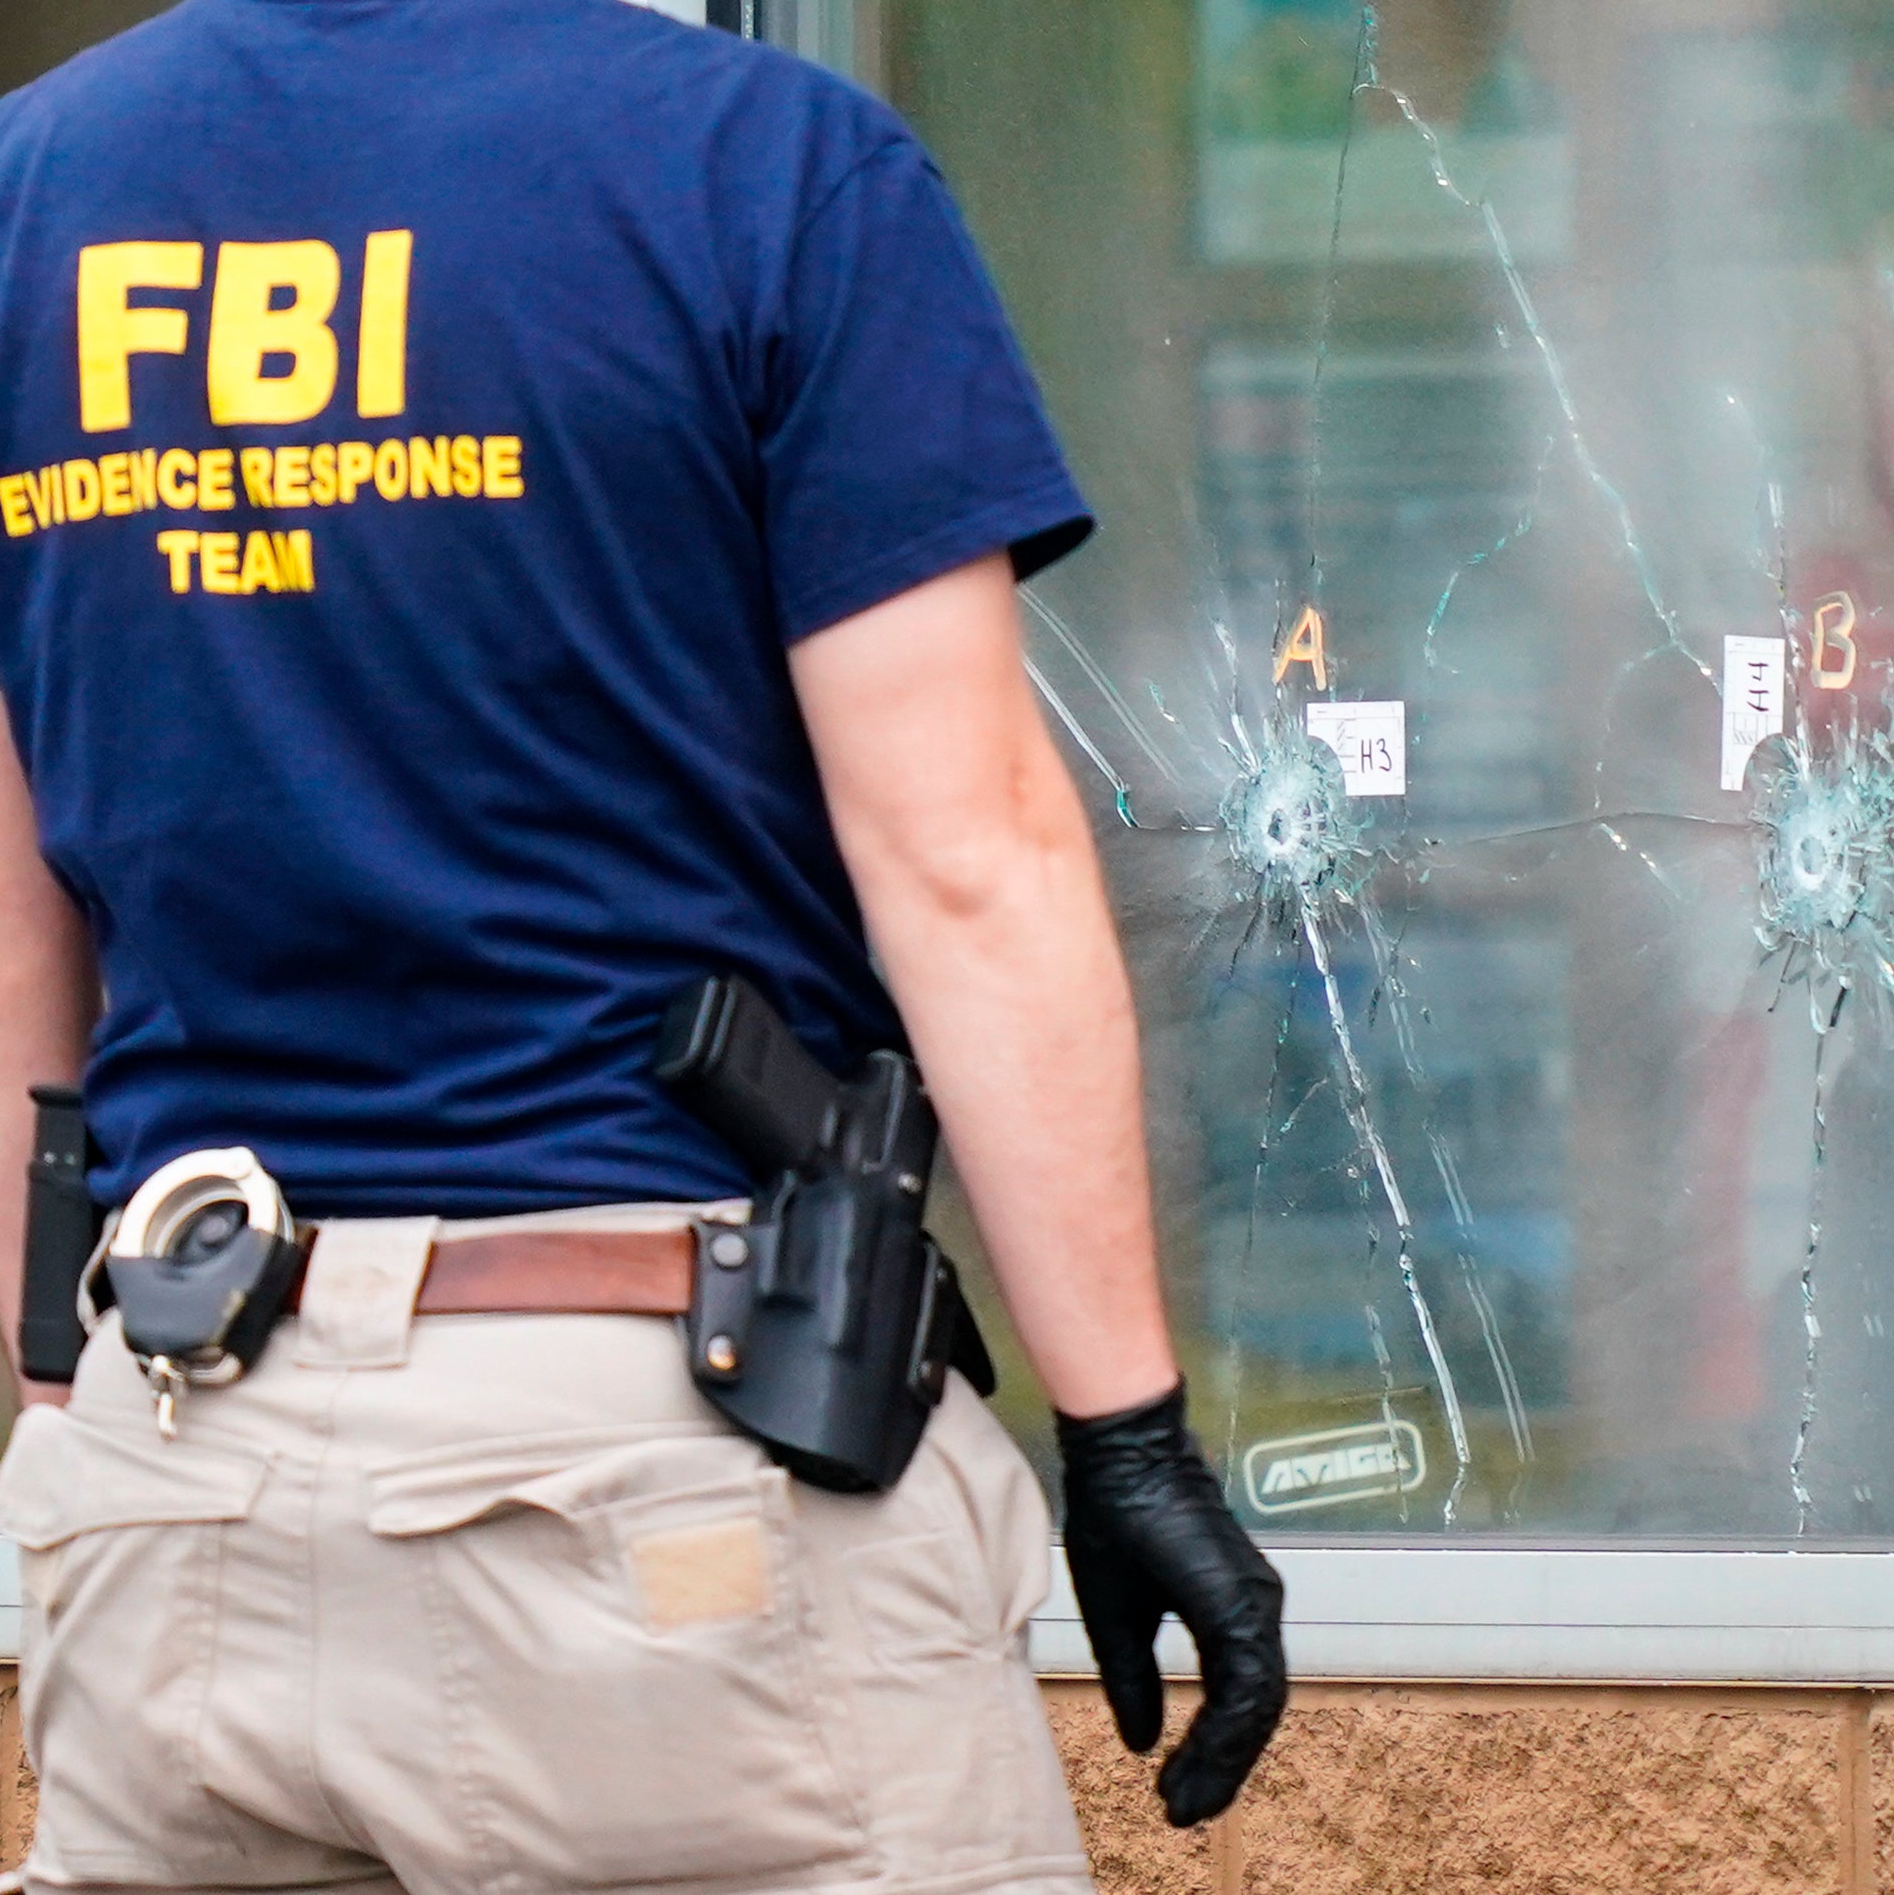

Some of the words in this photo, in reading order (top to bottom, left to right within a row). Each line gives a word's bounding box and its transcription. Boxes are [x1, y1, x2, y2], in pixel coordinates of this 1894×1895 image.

[78, 227, 413, 434] FBI
[241, 434, 524, 509] RESPONSE
[157, 529, 315, 594] TEAM
[1273, 607, 1328, 692] A
[1810, 591, 1857, 690] B
[1361, 738, 1393, 774] H3
